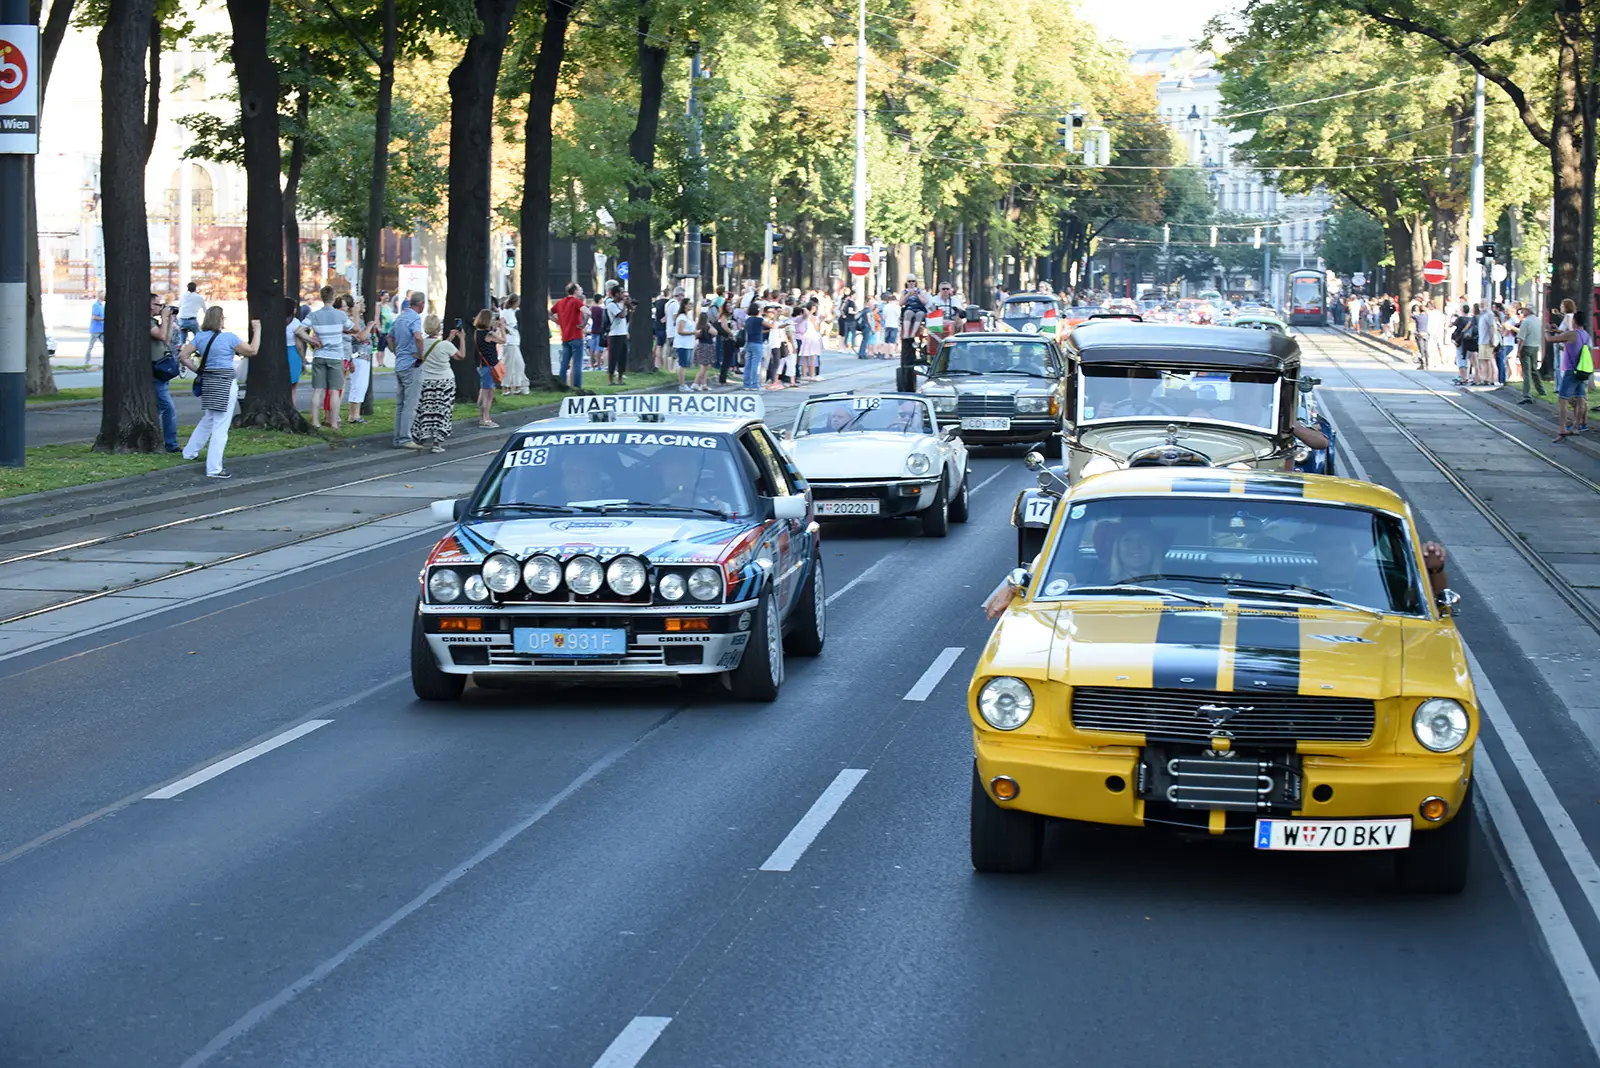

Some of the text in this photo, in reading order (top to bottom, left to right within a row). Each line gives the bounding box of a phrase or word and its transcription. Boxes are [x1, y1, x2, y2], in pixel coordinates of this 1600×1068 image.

[3, 119, 29, 129] Wien
[568, 396, 756, 414] MARTINI RACING
[856, 398, 880, 408] 118
[523, 434, 718, 449] MARTINI RACING
[509, 450, 546, 467] 198
[817, 504, 876, 513] W 20220 L
[1029, 502, 1051, 516] 17
[567, 633, 613, 649] 931F
[1284, 825, 1300, 846] W
[1319, 826, 1347, 846] 70
[1353, 825, 1397, 846] BKV
